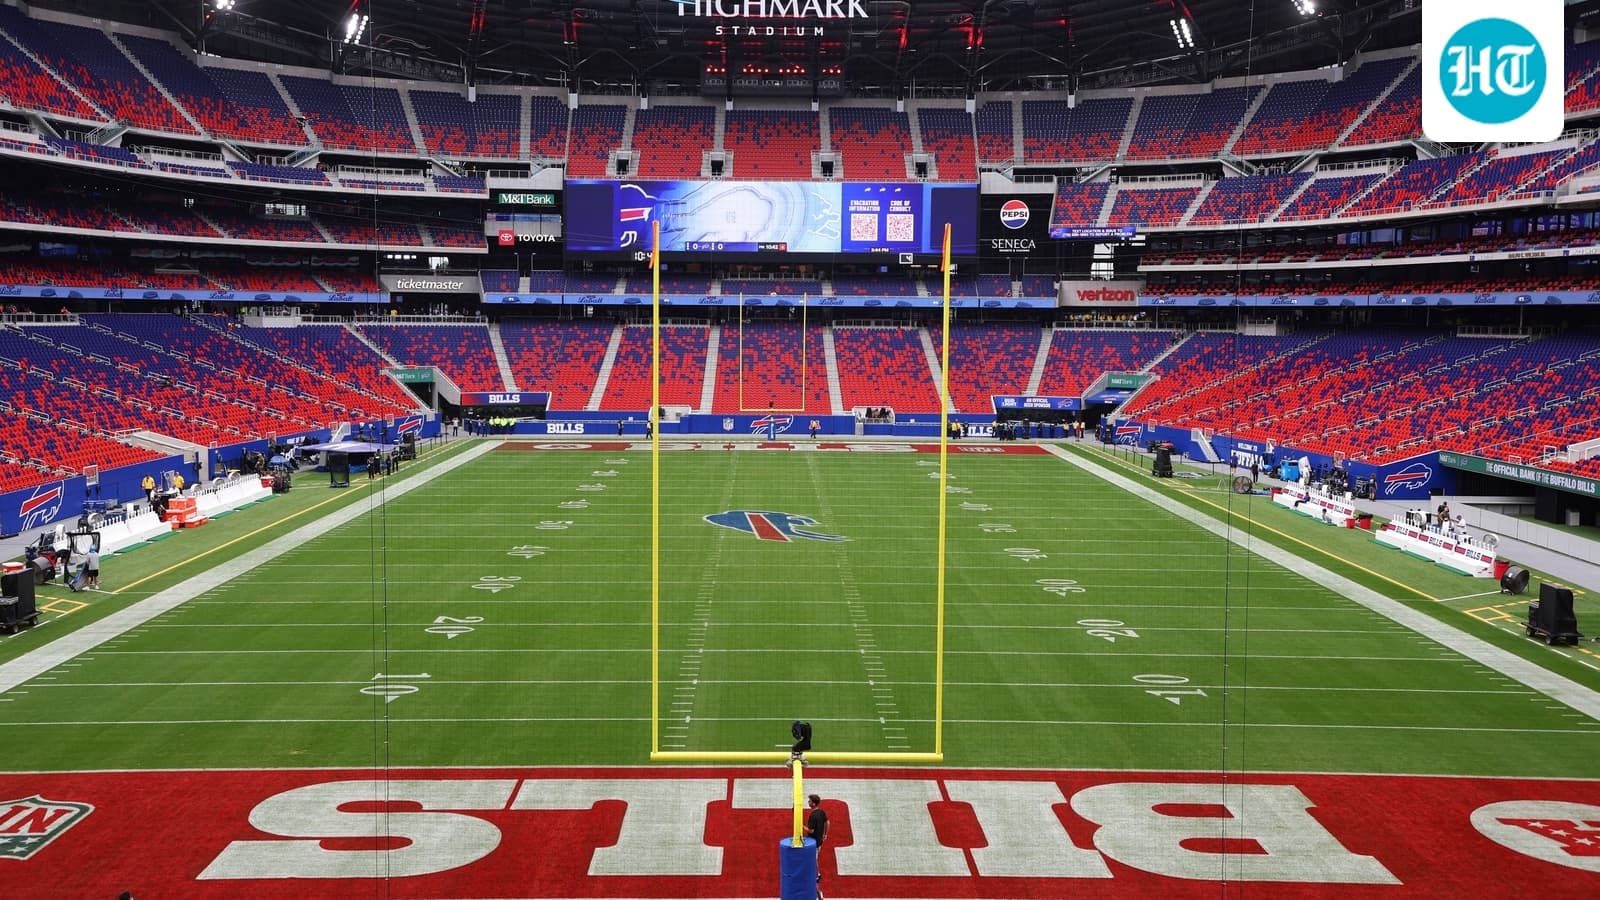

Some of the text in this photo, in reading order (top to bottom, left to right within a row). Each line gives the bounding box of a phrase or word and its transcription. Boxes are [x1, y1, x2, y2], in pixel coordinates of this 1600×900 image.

[678, 0, 869, 18] HIGHMARK
[715, 26, 824, 36] STADIUM
[518, 234, 555, 242] TOYOTA
[991, 239, 1036, 248] SENECA
[397, 278, 463, 290] ticketmaster
[1077, 287, 1135, 301] verizon
[488, 394, 520, 404] BILLS
[546, 423, 585, 434] BILLS
[1485, 462, 1596, 493] THE OFFICIAL BANK OF THE BUFFALO BILLS
[1396, 525, 1408, 536] BILLS
[1428, 536, 1442, 548] BILLS
[1465, 548, 1481, 561] BILLS
[424, 615, 484, 635] 20
[1076, 619, 1140, 638] 20
[359, 672, 432, 696] 10
[1132, 673, 1208, 697] 10
[195, 778, 1403, 885] BILLS
